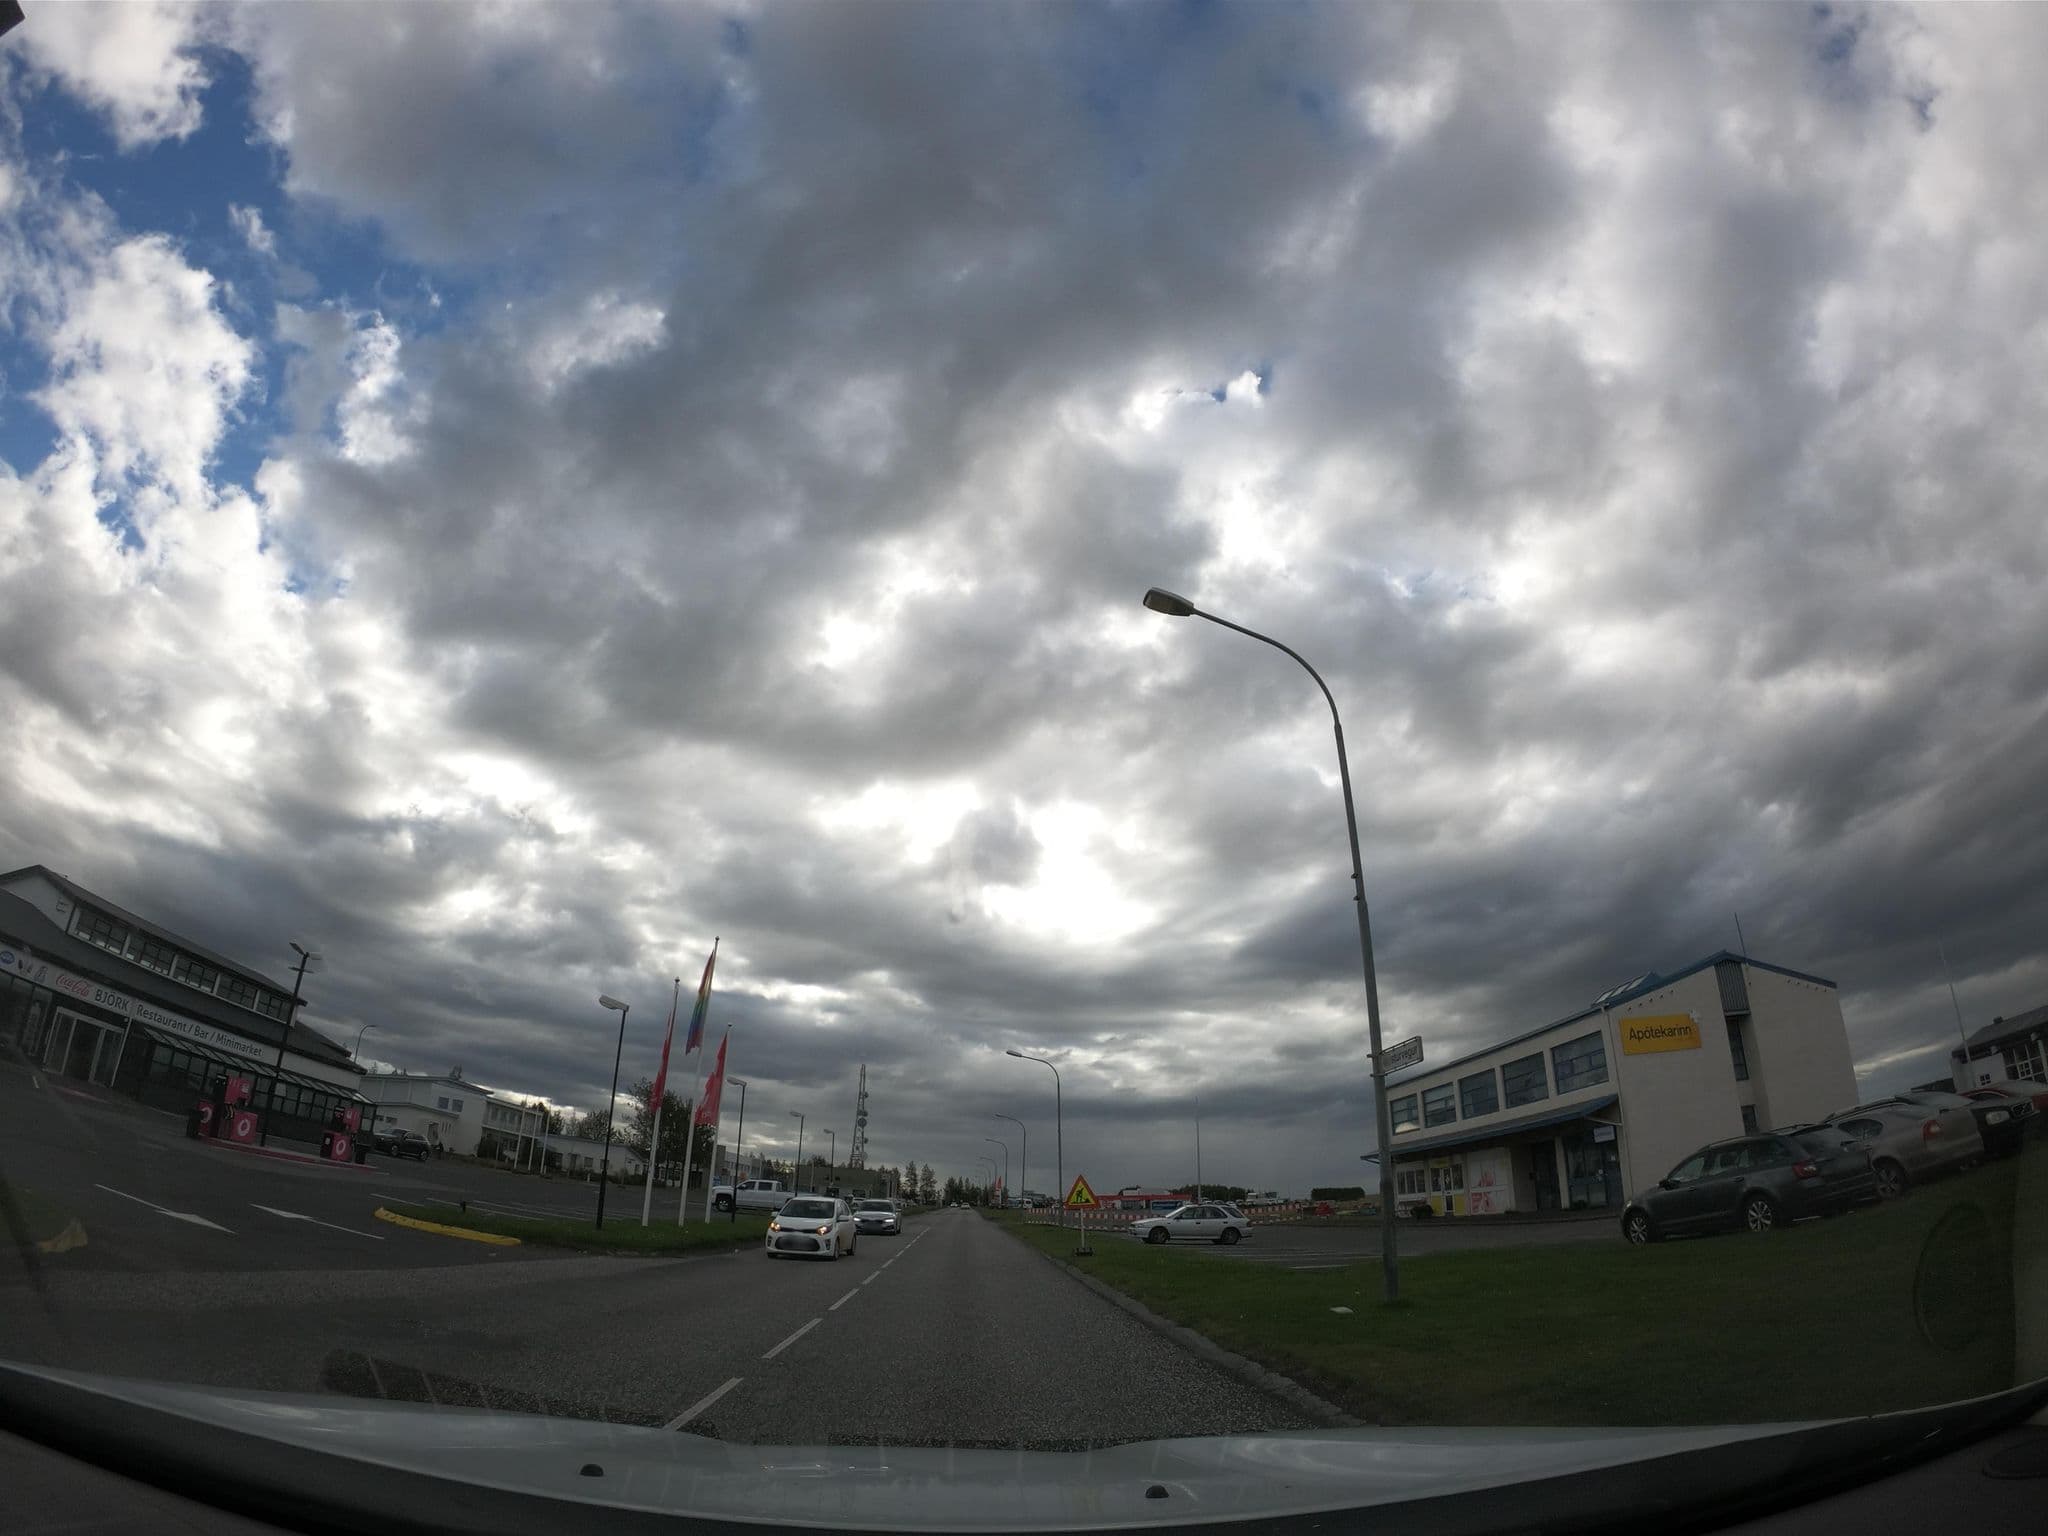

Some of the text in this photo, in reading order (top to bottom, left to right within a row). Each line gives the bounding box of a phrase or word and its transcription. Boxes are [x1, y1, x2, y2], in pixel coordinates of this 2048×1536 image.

[136, 1004, 186, 1032] Restaurant
[194, 1025, 209, 1040] Bar
[215, 1033, 263, 1057] Minimarket
[1629, 1023, 1692, 1042] Apótekarinn
